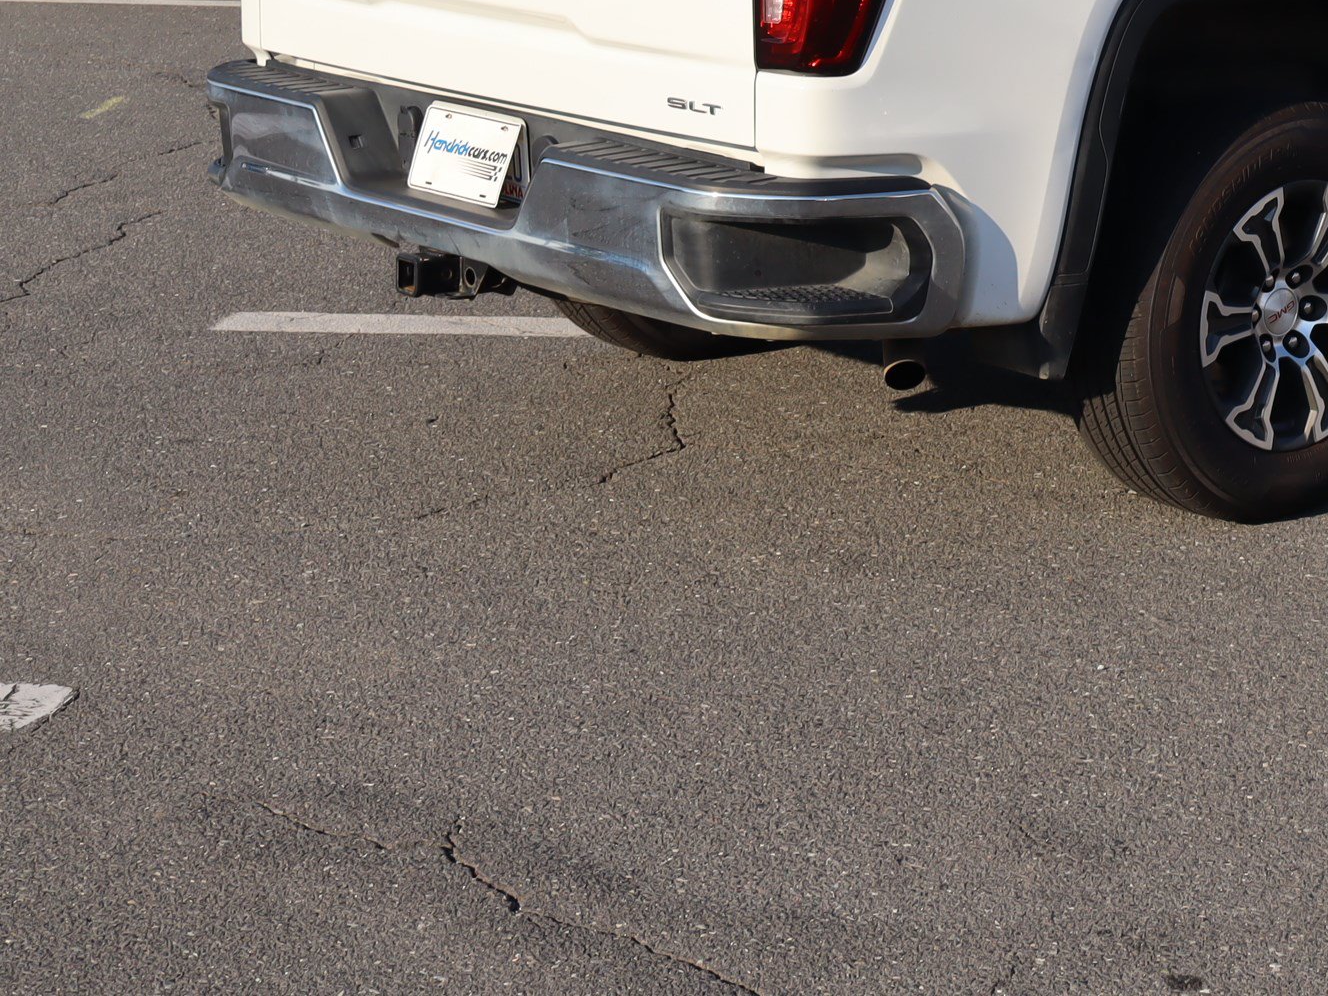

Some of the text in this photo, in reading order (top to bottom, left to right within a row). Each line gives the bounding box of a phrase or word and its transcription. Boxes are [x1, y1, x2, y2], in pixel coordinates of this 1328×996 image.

[667, 97, 722, 115] SLT
[424, 130, 507, 164] Hendrickcars.com
[1267, 300, 1296, 324] GMC
